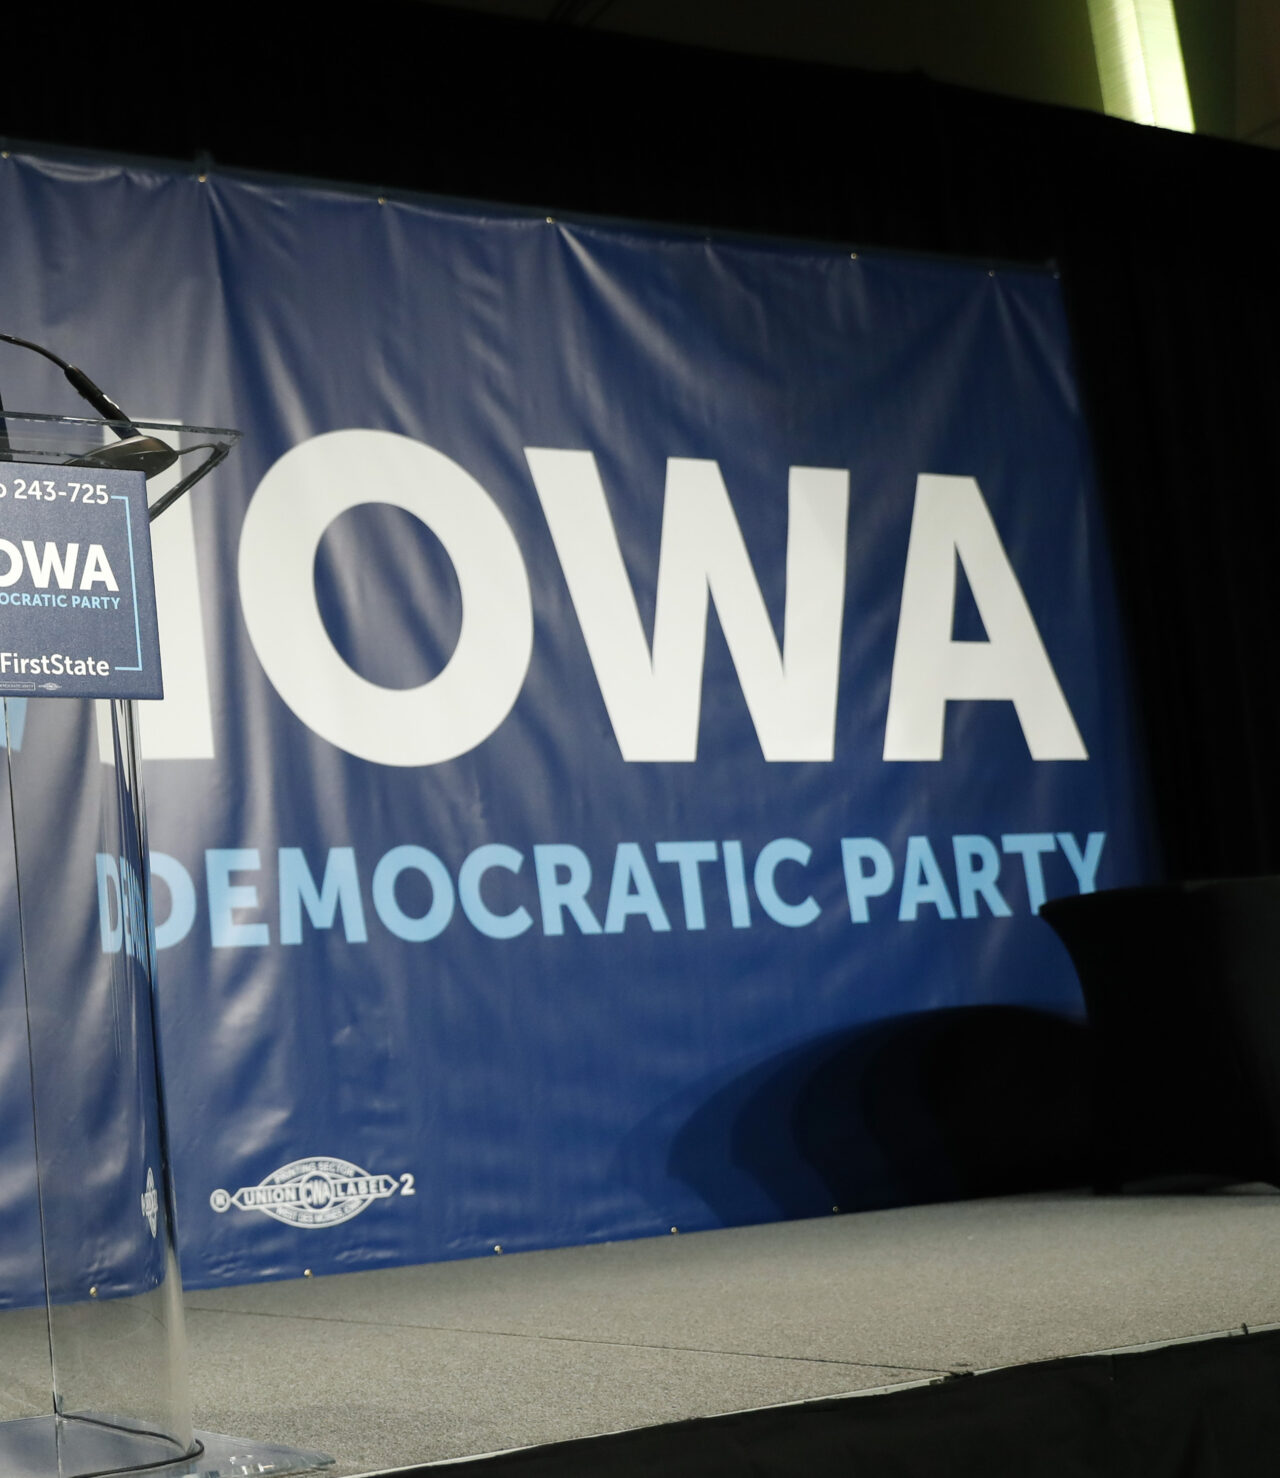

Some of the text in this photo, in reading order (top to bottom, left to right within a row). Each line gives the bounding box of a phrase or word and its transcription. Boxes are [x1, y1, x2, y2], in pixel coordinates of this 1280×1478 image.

[13, 479, 109, 505] 243-725
[71, 595, 120, 610] PARTY
[96, 419, 1089, 767] IOWA
[96, 831, 1106, 953] DEMOCRATIC PARTY
[243, 1187, 297, 1206] UNION
[304, 1179, 331, 1206] CWA
[335, 1179, 388, 1197] LABEL
[400, 1173, 416, 1196] 2
